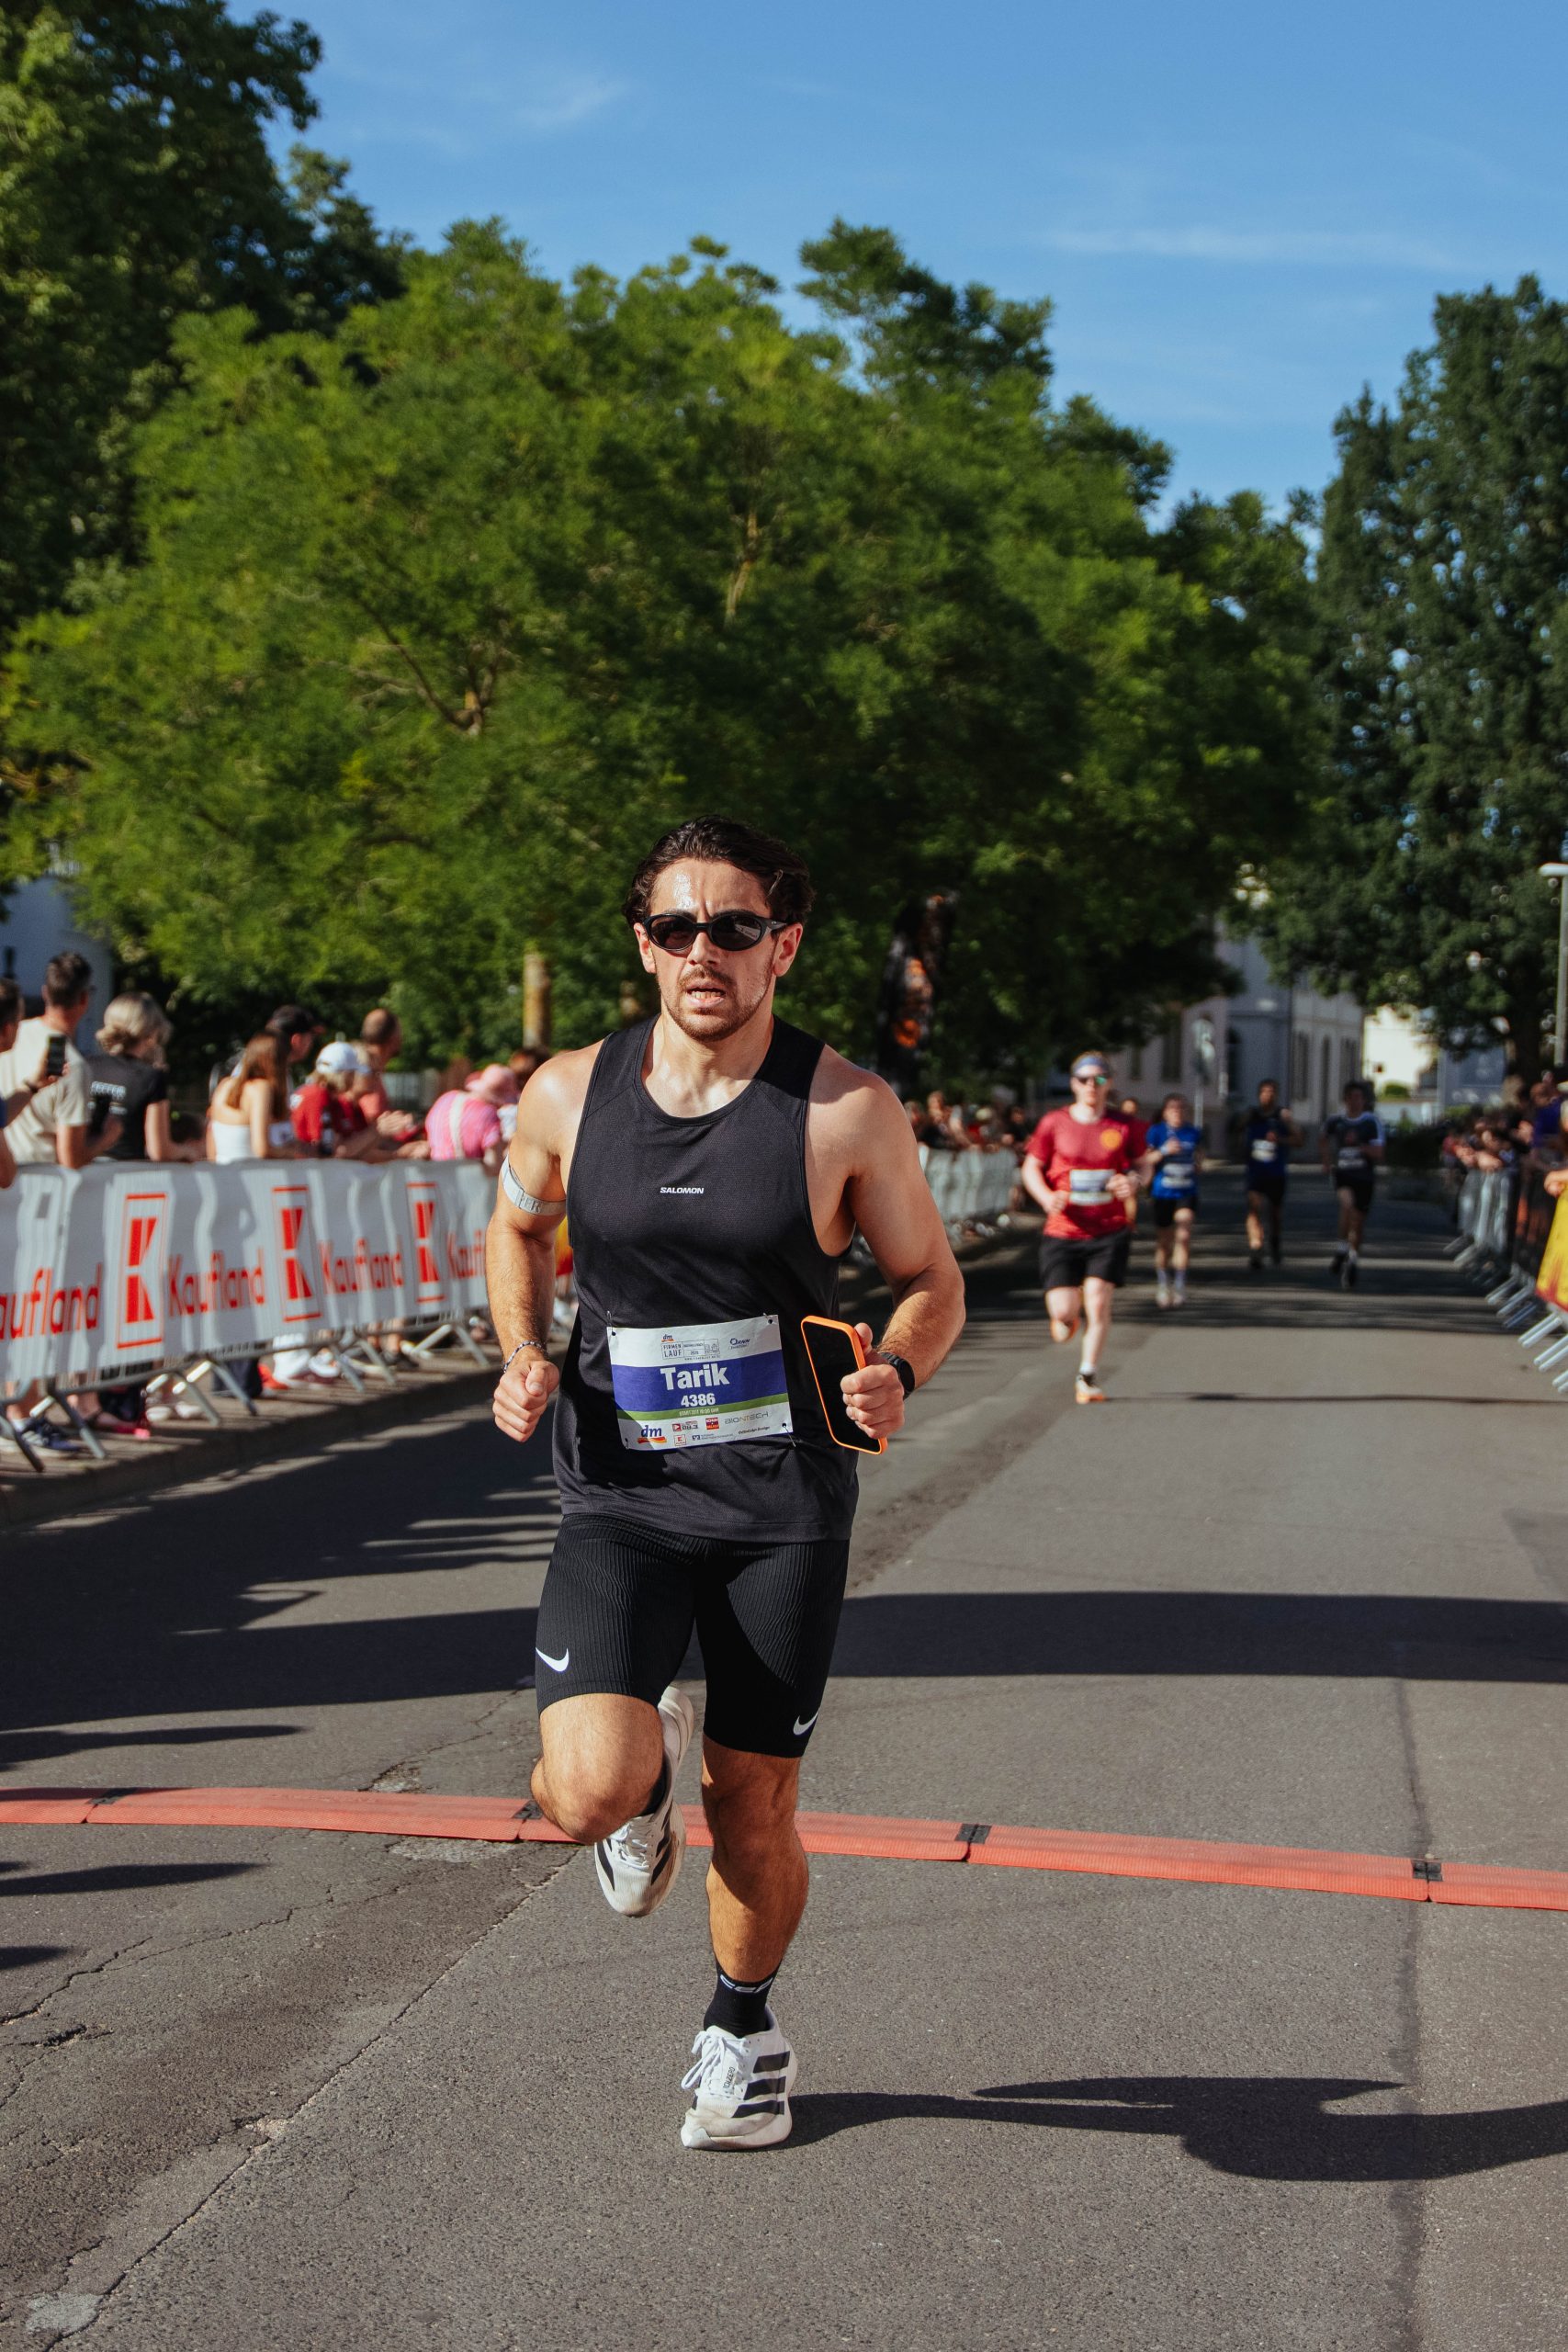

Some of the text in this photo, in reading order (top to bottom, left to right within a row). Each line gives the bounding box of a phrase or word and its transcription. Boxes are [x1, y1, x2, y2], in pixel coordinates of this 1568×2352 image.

[660, 1186, 705, 1194] SALOMON
[167, 1248, 266, 1317] Kaufland
[663, 1349, 682, 1358] LAUF
[660, 1363, 729, 1390] Tarik
[681, 1393, 716, 1407] 4386
[724, 1411, 768, 1424] BIONTECH
[641, 1425, 662, 1437] dm
